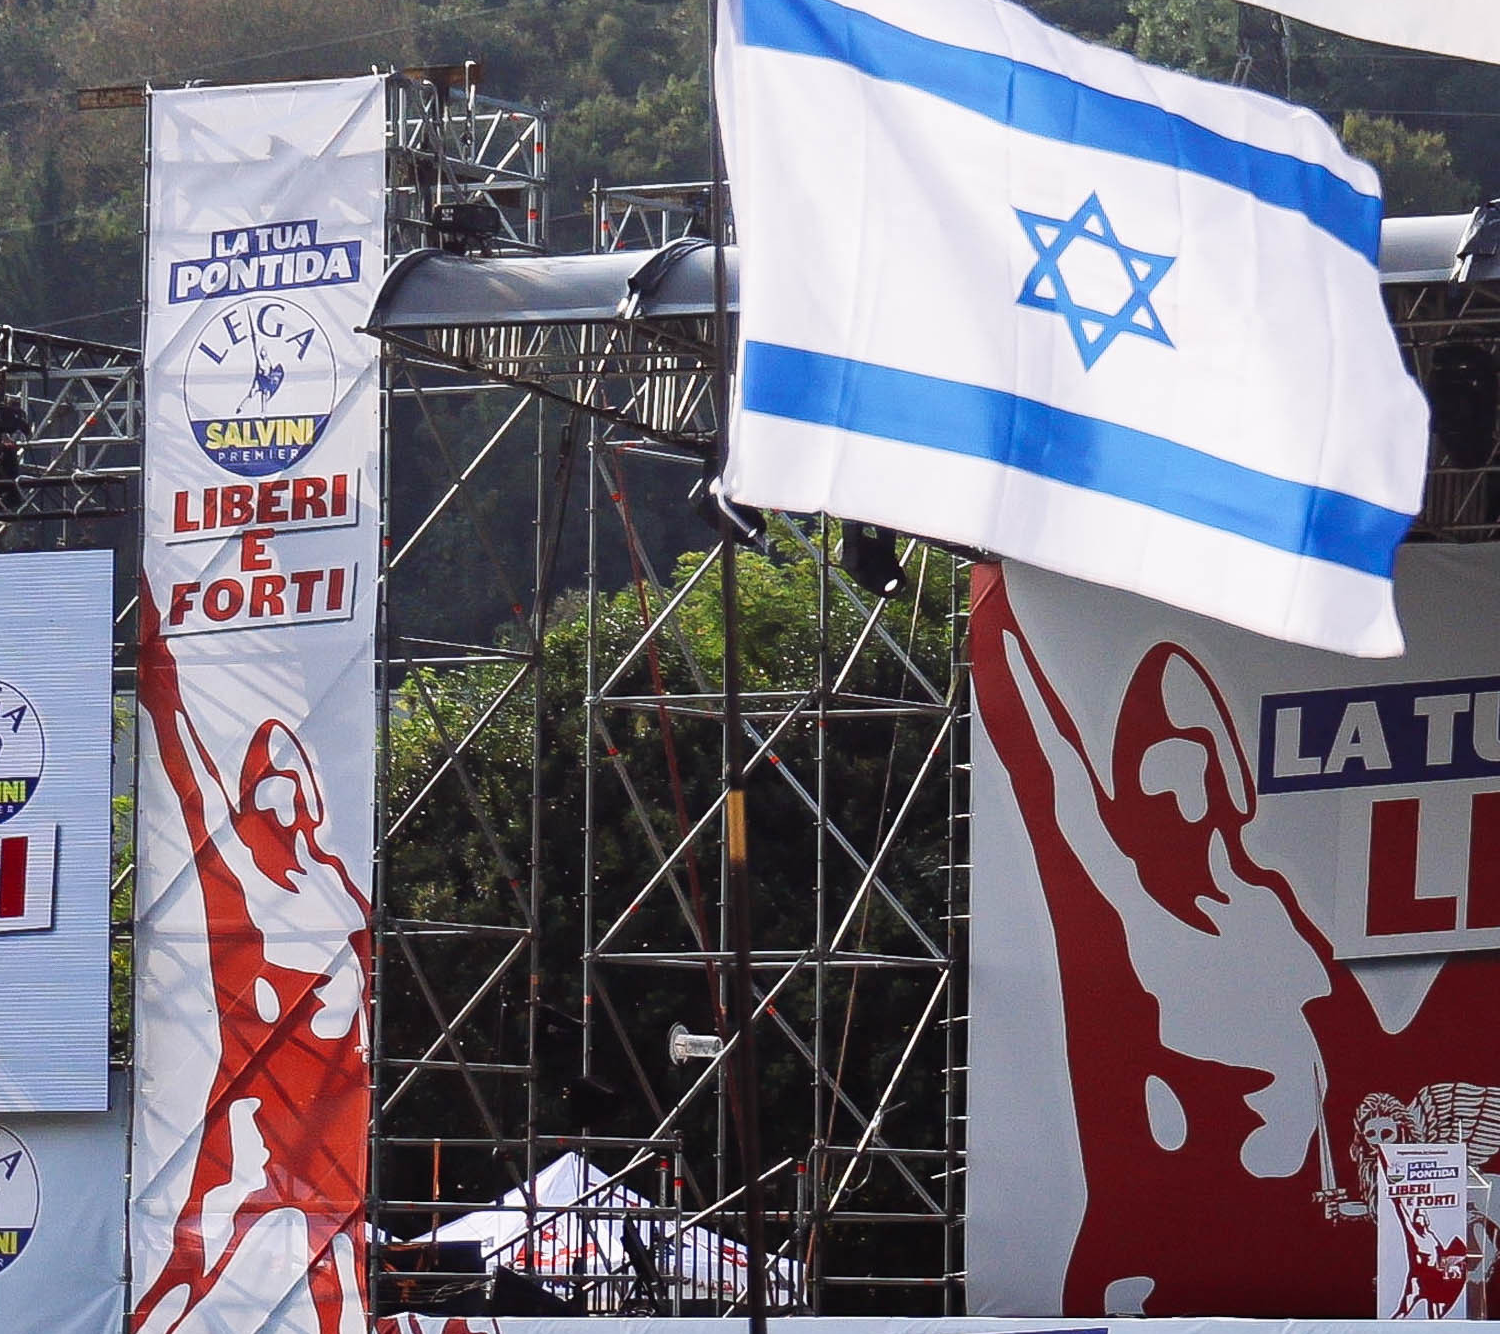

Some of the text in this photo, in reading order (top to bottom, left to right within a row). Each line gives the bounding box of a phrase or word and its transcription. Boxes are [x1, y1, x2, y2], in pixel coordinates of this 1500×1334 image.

[217, 224, 311, 255] LA TUA
[175, 248, 353, 299] PONTIDA
[198, 302, 316, 366] LEGA
[205, 417, 315, 449] SALVINI
[217, 449, 301, 463] PREMIER
[173, 473, 349, 534] LIBERI
[240, 529, 276, 572] E
[169, 568, 346, 627] FORTI
[1272, 701, 1391, 779] LA
[1388, 1184, 1431, 1196] LIBERI
[1408, 1168, 1457, 1179] PONTIDA
[1417, 1195, 1456, 1207] FORTI
